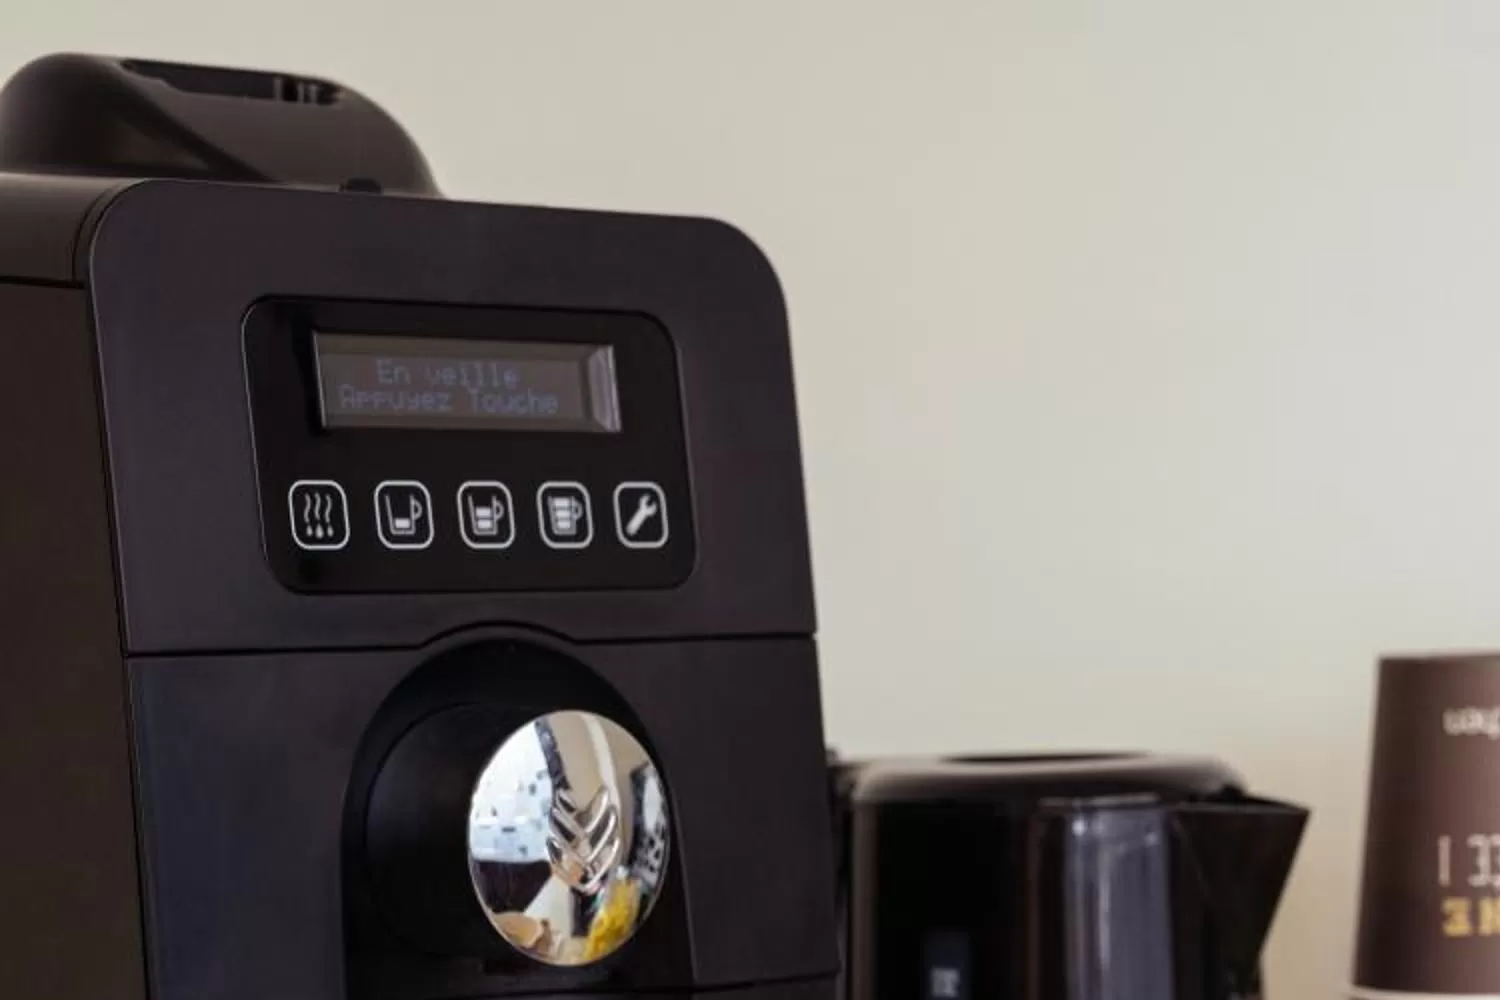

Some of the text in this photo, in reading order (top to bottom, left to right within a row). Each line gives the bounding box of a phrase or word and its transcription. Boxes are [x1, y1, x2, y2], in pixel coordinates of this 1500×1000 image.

[376, 359, 520, 389] En veille
[469, 388, 560, 413] Touche
